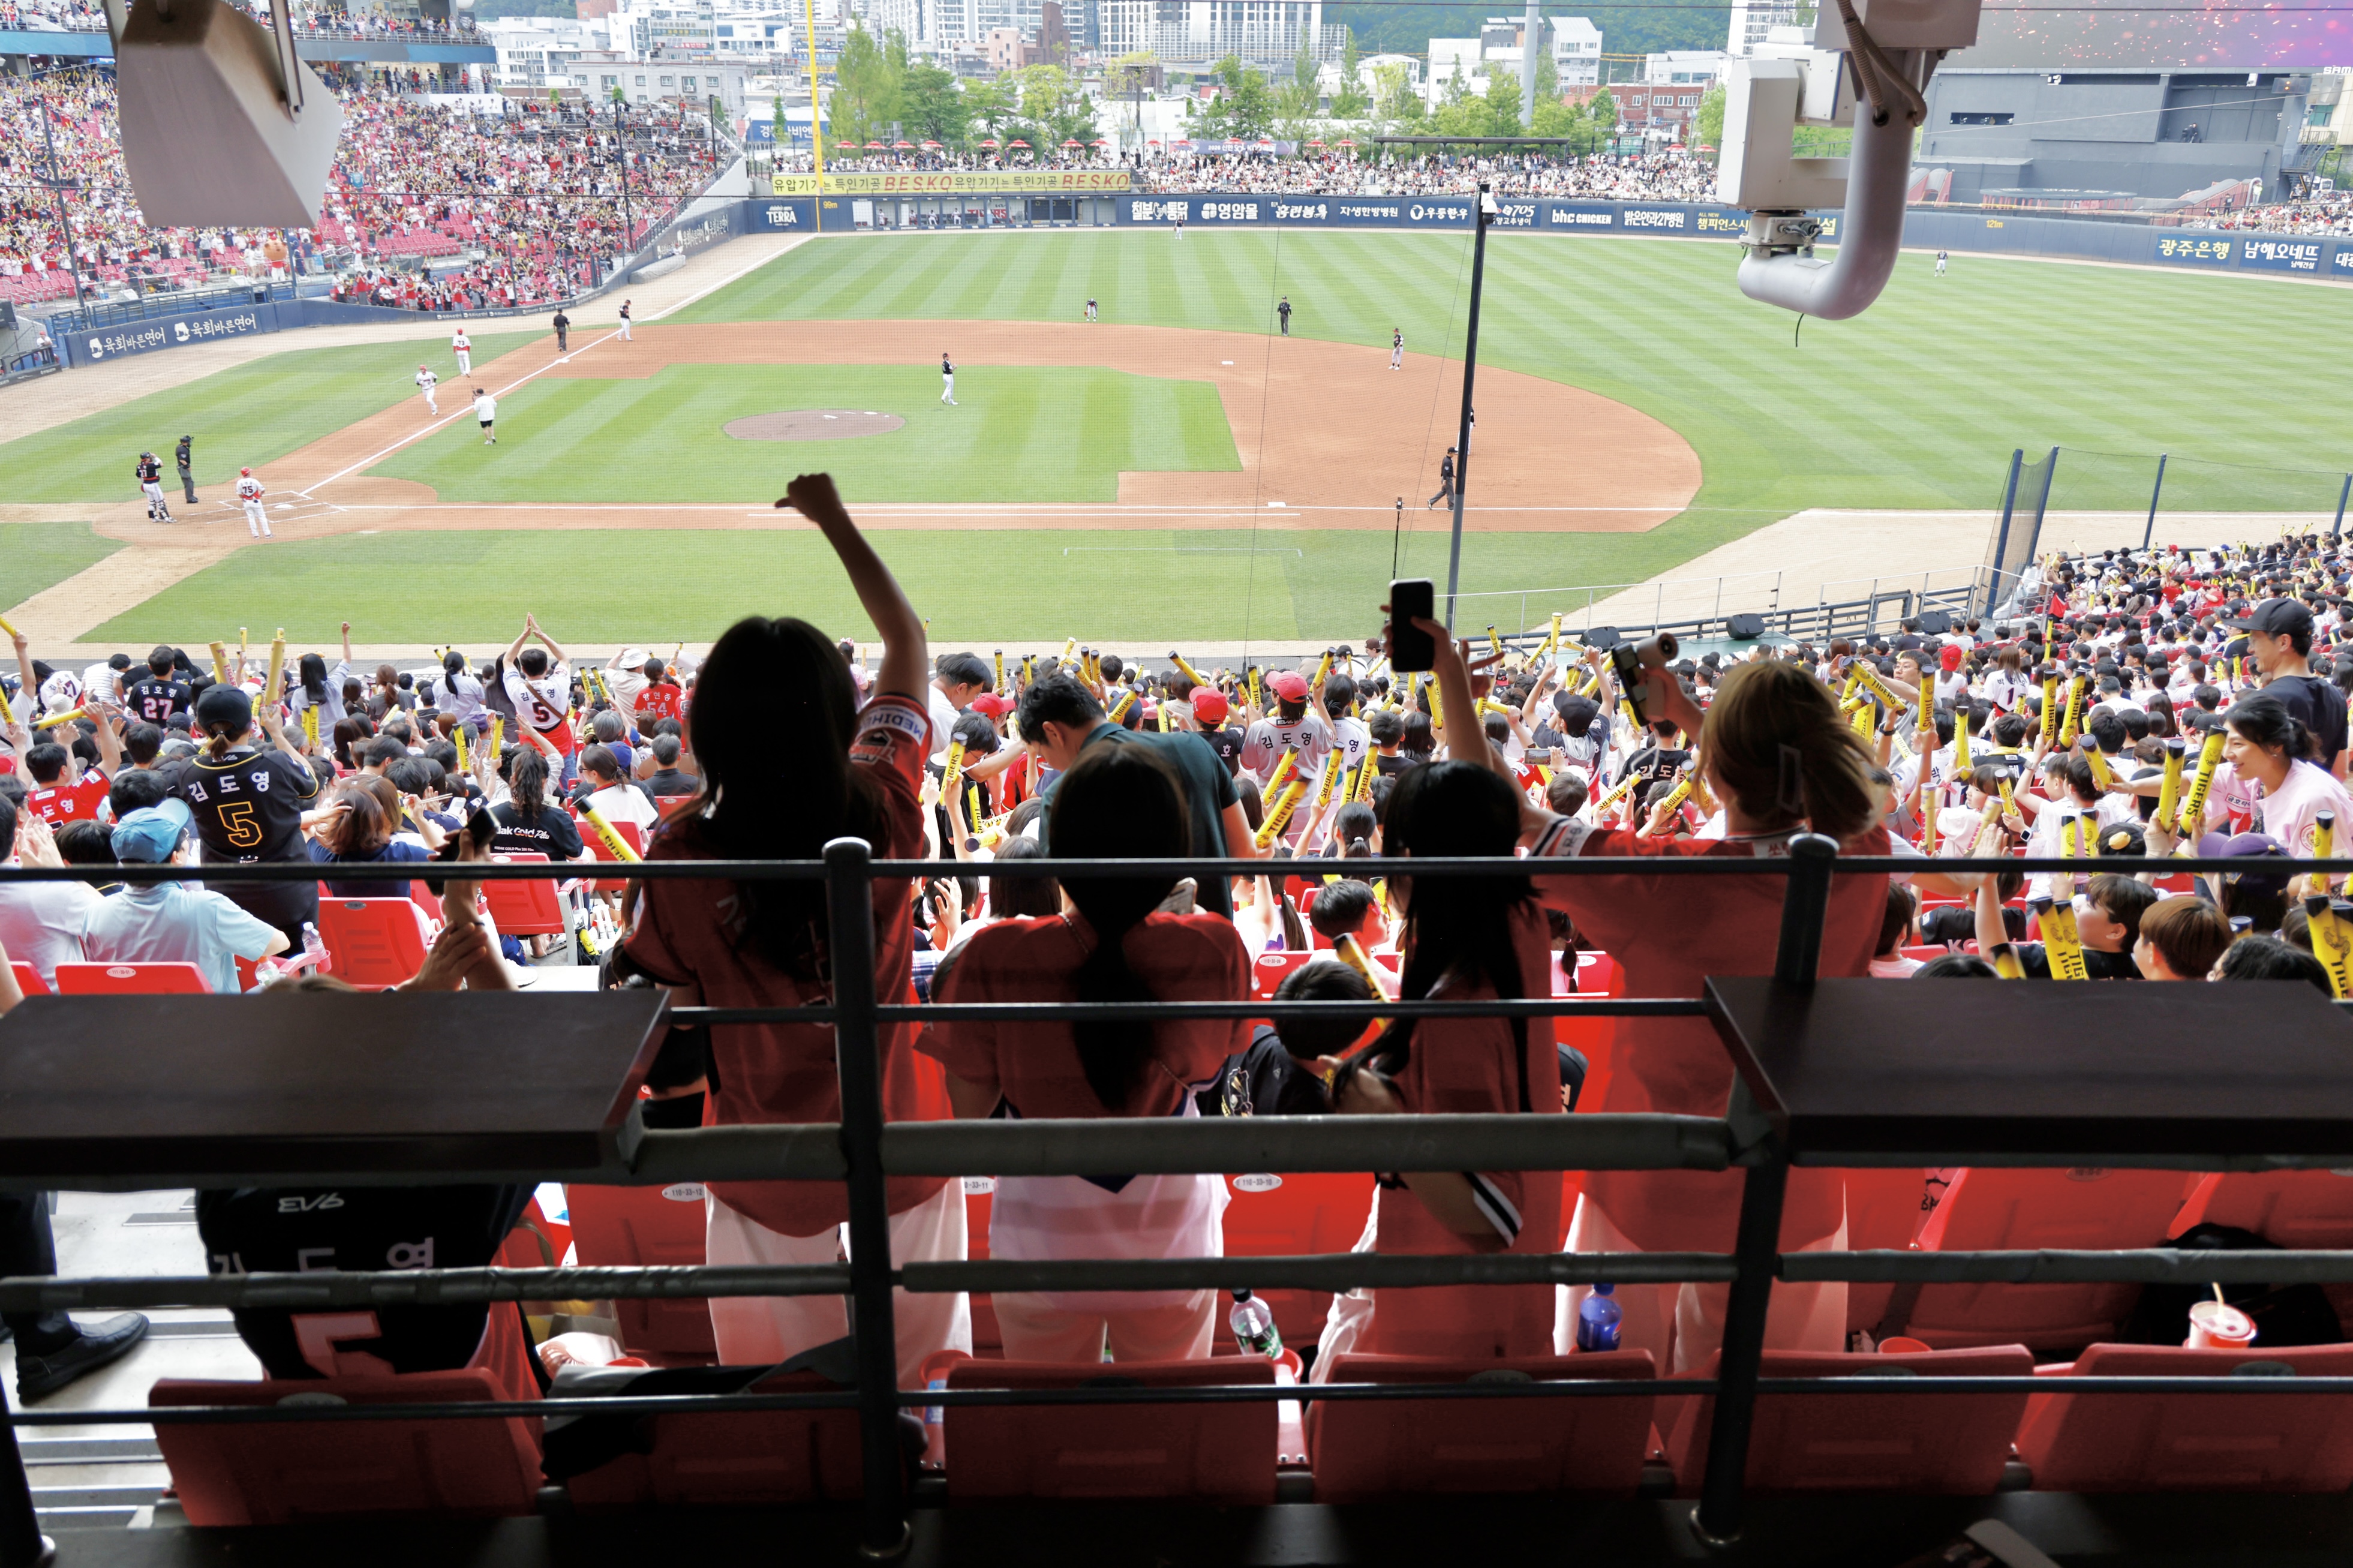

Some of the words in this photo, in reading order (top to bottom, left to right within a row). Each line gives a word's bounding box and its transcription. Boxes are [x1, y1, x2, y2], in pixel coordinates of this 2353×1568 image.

[2323, 66, 2353, 74] SAM
[884, 176, 952, 191] BESKO
[1062, 174, 1129, 189] BESKO
[823, 200, 838, 209] 99m
[1218, 203, 1258, 220] 영암몰
[1340, 206, 1399, 218] 자생한방병원
[1511, 205, 1536, 218] 705
[766, 210, 797, 224] TERRA
[1493, 217, 1531, 226] 양고추냉이
[1552, 209, 1575, 224] bhc
[1576, 214, 1612, 225] CHICKEN
[1624, 211, 1684, 229] 밝은안과21병원
[1697, 218, 1750, 232] 챔피언스시
[1986, 220, 2004, 229] 121m
[2159, 238, 2231, 260] 광주은행
[2245, 241, 2319, 261] 남해오네뜨
[2291, 260, 2315, 270] 남해건설
[190, 313, 257, 338] 육회바른연어
[104, 327, 167, 354] 육회바른연어
[242, 485, 254, 494] 75
[521, 688, 555, 702] 김영
[1870, 679, 1897, 705] TIGERS
[2007, 687, 2014, 705] 1
[144, 696, 174, 720] 27
[532, 701, 550, 723] 5
[647, 701, 668, 716] 54
[1116, 696, 1134, 717] TIGERS
[1923, 698, 1933, 728] TIGERS
[2070, 687, 2084, 722] TIGERS
[2045, 704, 2055, 737] TIGERS
[1261, 732, 1312, 749] 김도영
[1895, 735, 1912, 758] TIGERS
[189, 771, 269, 803] 김도영
[1321, 770, 1334, 799] TIGERS
[2186, 770, 2212, 817] TIGERS
[1599, 786, 1626, 811] TIGERS
[1664, 791, 1681, 813] TIGER
[1267, 794, 1300, 833] TIGERS
[217, 801, 263, 847] 5
[514, 827, 534, 838] Gold
[534, 830, 550, 840] Plus
[671, 1188, 703, 1197] 110-33-12
[278, 1192, 345, 1213] EV6
